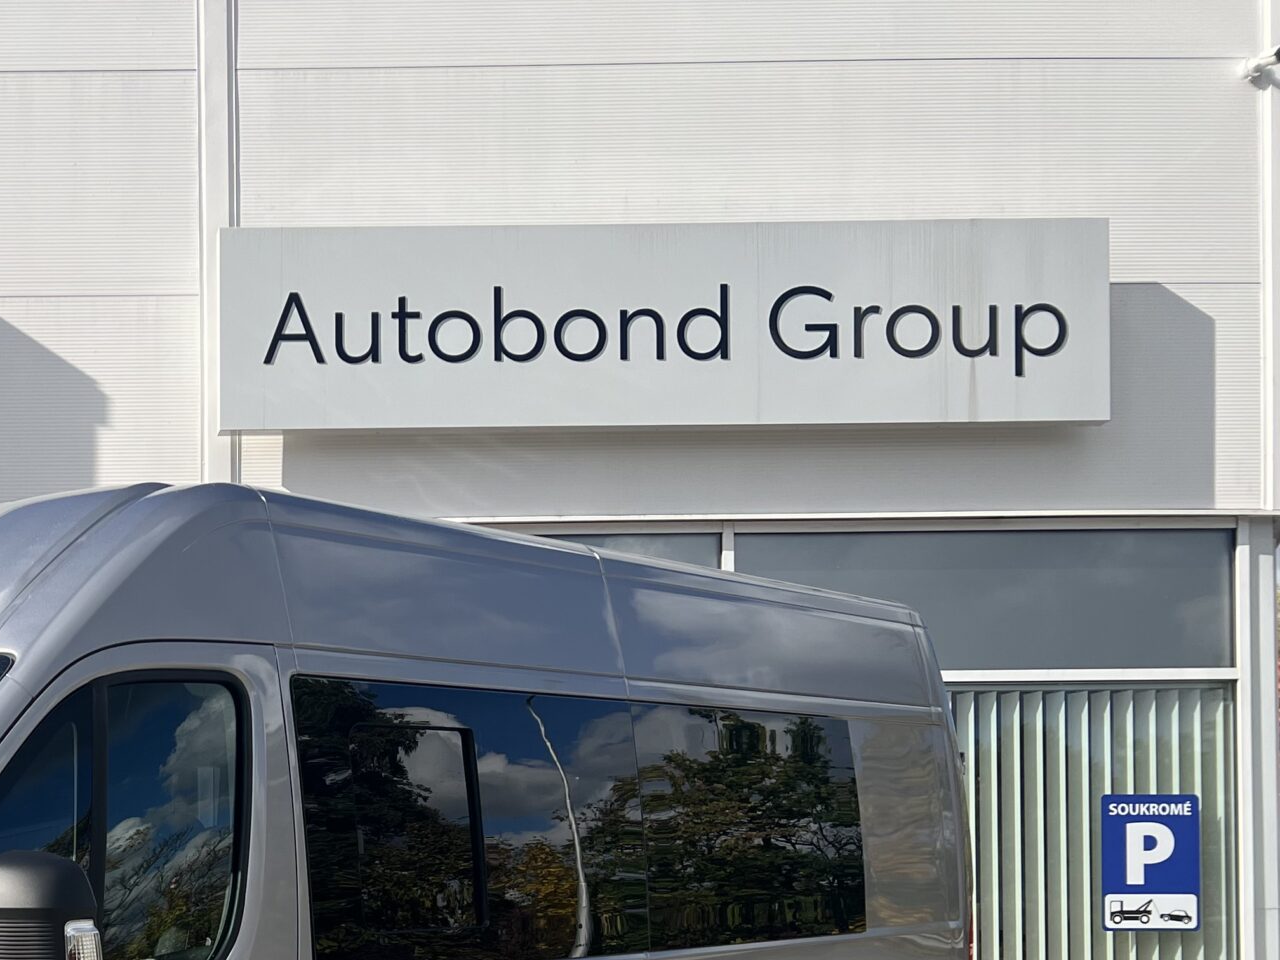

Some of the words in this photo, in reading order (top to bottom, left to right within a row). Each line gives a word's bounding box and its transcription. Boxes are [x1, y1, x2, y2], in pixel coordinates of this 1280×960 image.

[263, 283, 731, 366] Autobond
[768, 285, 1069, 378] Group
[1108, 801, 1192, 816] SOUKROMÉ
[1125, 821, 1175, 886] P
